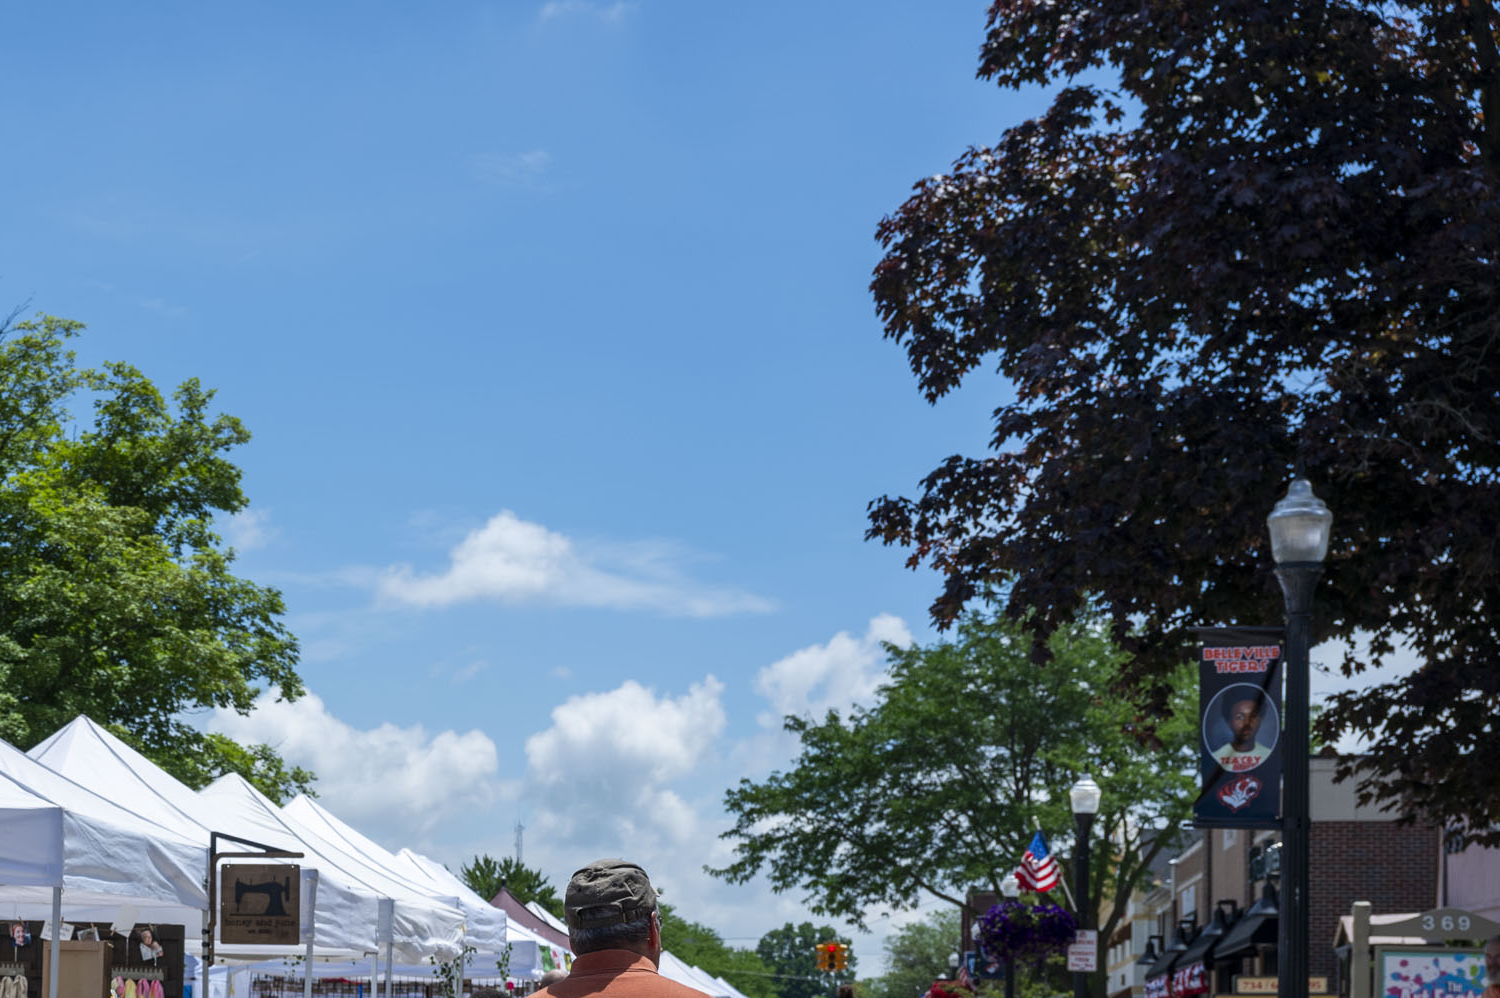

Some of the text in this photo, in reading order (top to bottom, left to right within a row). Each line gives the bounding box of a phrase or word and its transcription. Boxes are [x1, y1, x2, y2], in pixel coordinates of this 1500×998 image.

[1203, 646, 1280, 661] BELLEVILLE
[1214, 659, 1270, 674] TIGERS
[1421, 915, 1471, 931] 369
[1447, 981, 1463, 995] The
